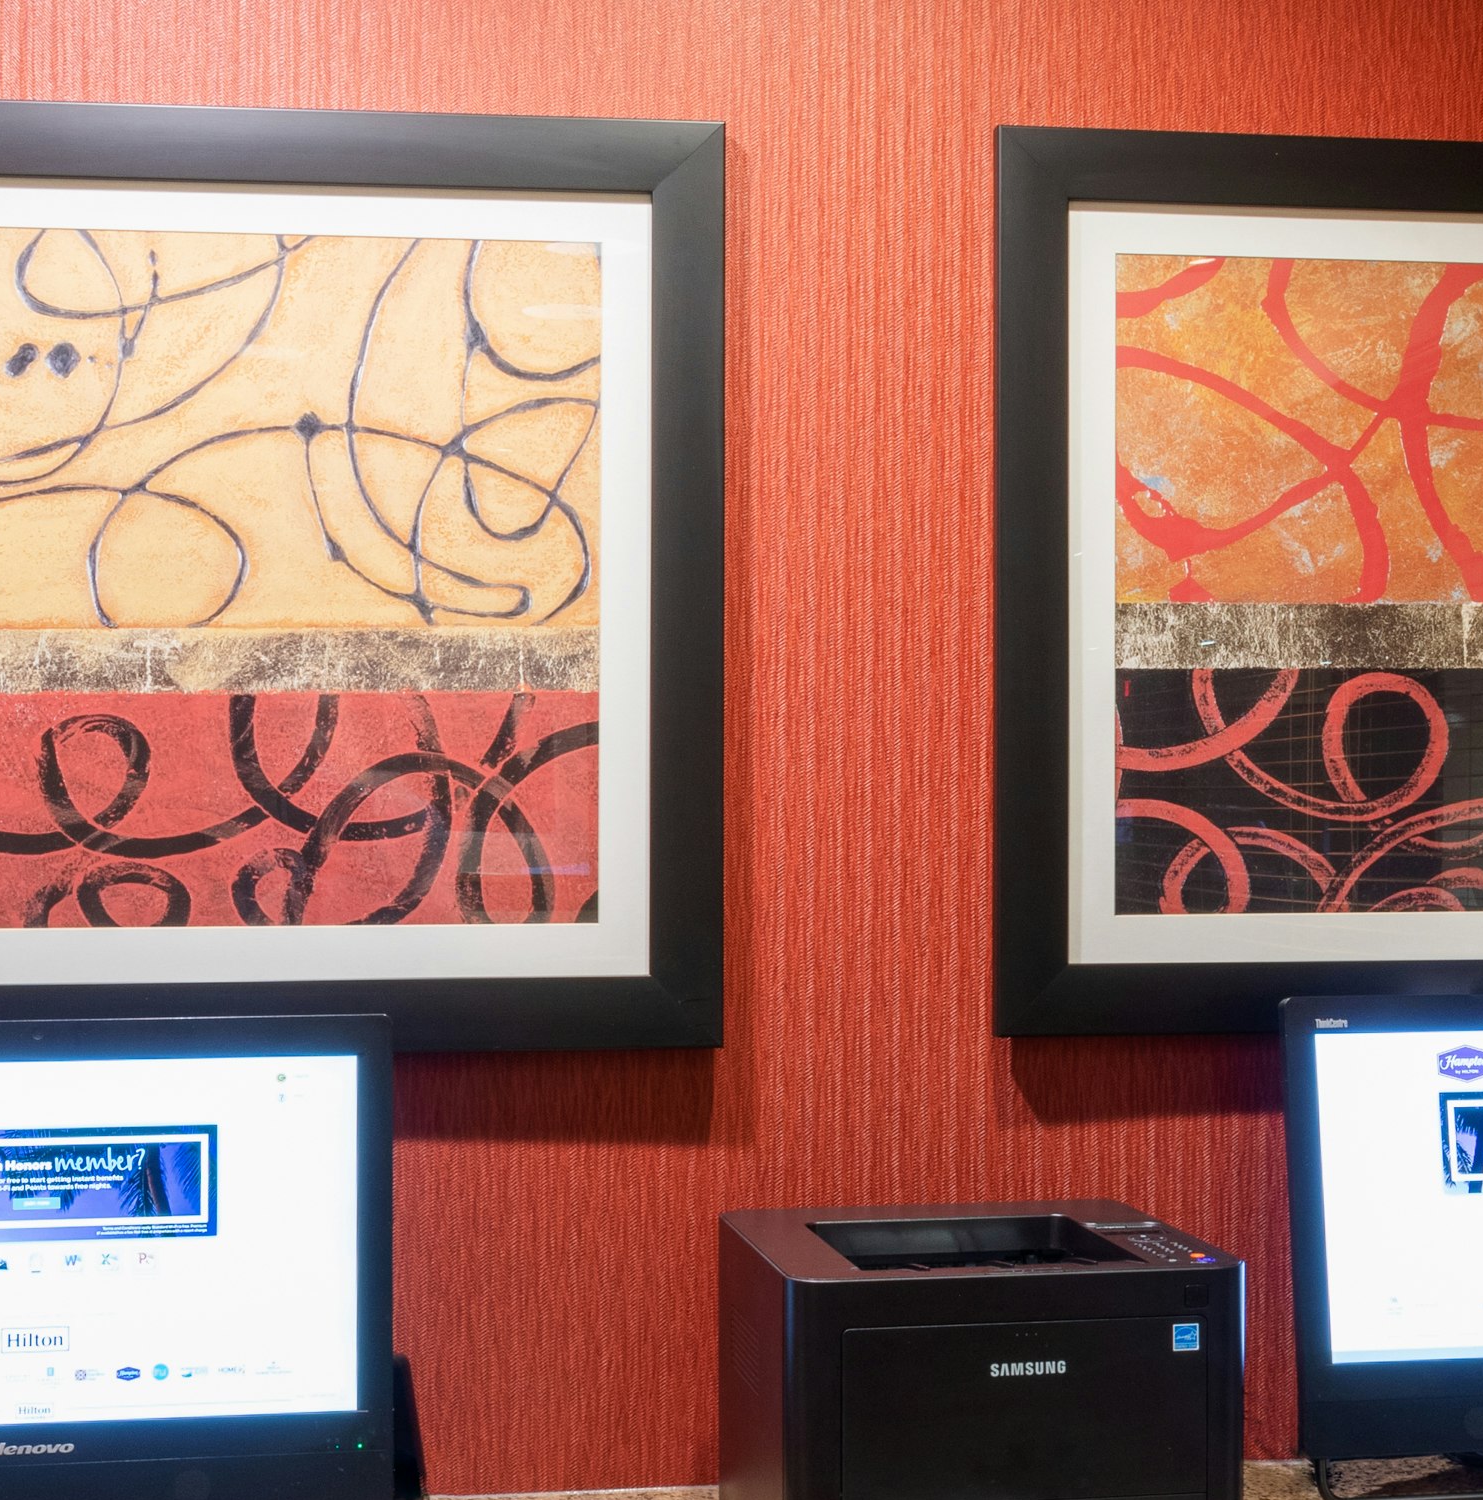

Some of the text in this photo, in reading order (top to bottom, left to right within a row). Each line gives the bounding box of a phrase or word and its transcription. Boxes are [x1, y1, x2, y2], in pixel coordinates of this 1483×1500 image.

[4, 1159, 53, 1172] Honors
[54, 1147, 146, 1172] member?
[7, 1333, 64, 1348] Hilton
[990, 1360, 1067, 1377] SAMSUNG
[18, 1404, 51, 1415] Hilton
